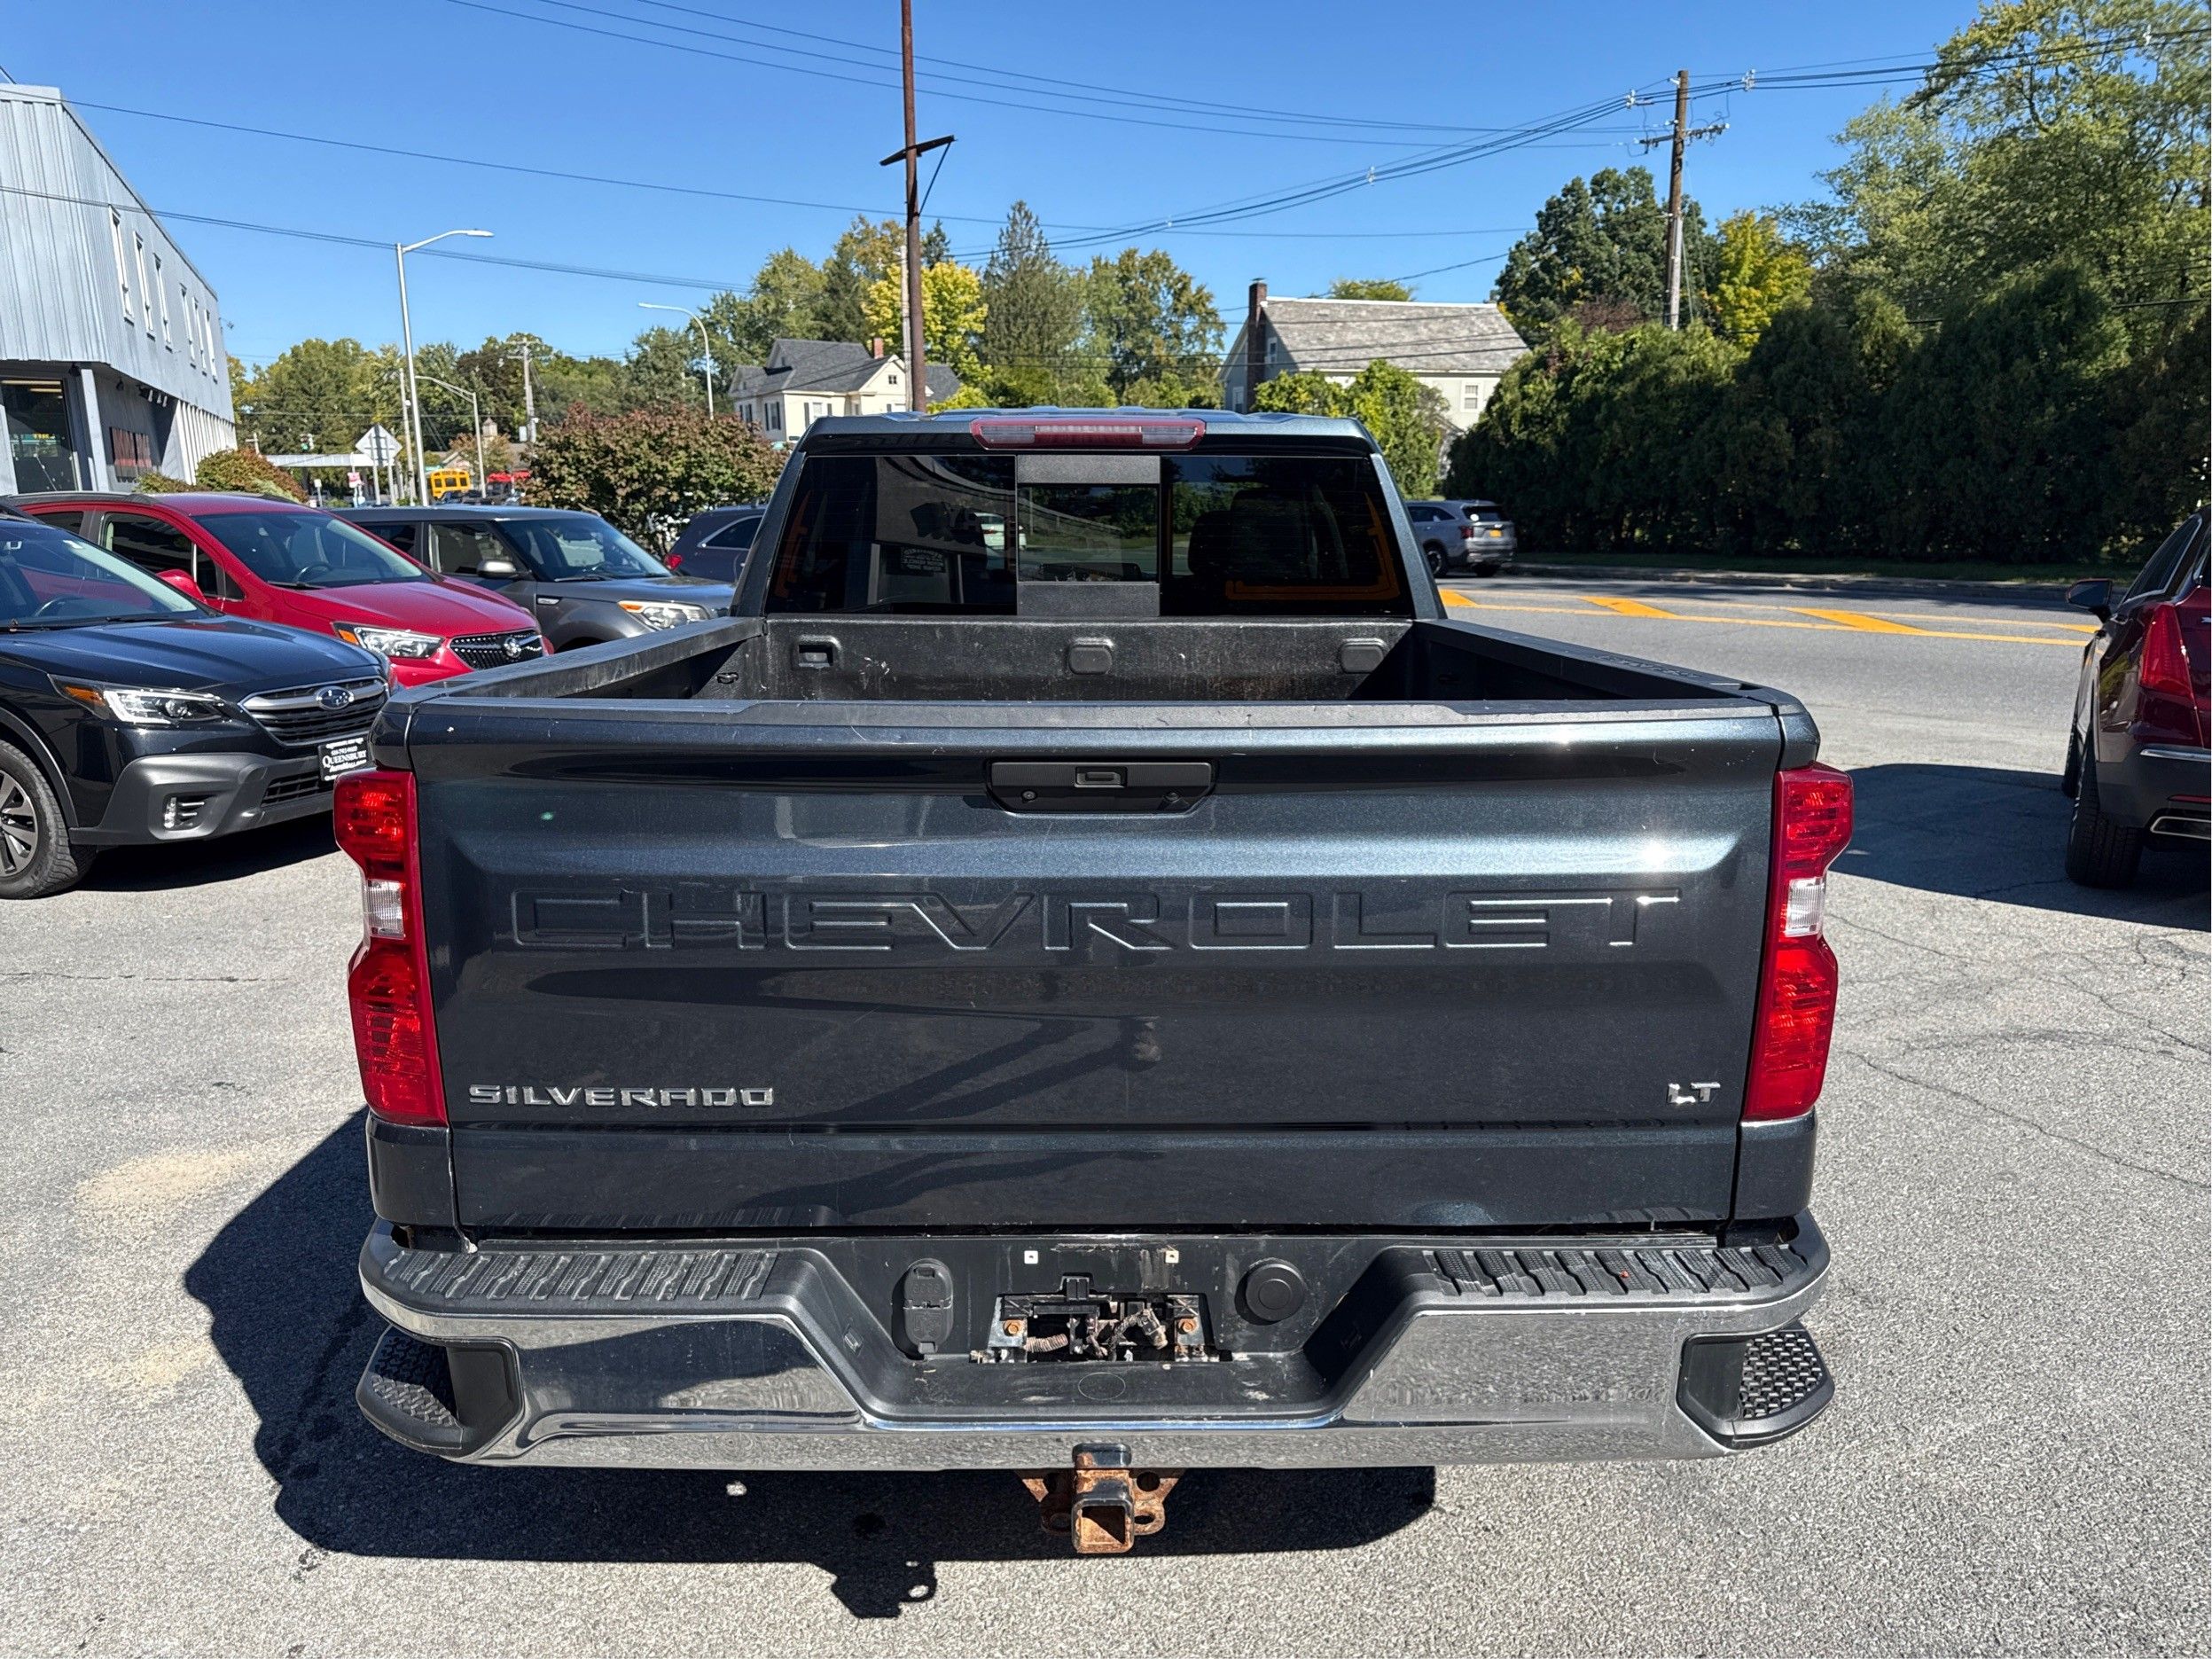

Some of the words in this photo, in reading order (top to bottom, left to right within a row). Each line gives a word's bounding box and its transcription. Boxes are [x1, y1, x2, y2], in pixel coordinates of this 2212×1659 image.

[323, 751, 367, 769] QUEENSBURY
[511, 888, 1683, 951] CHEVROLET
[469, 1084, 774, 1107] SILVERADO
[1668, 1082, 1721, 1104] LT
